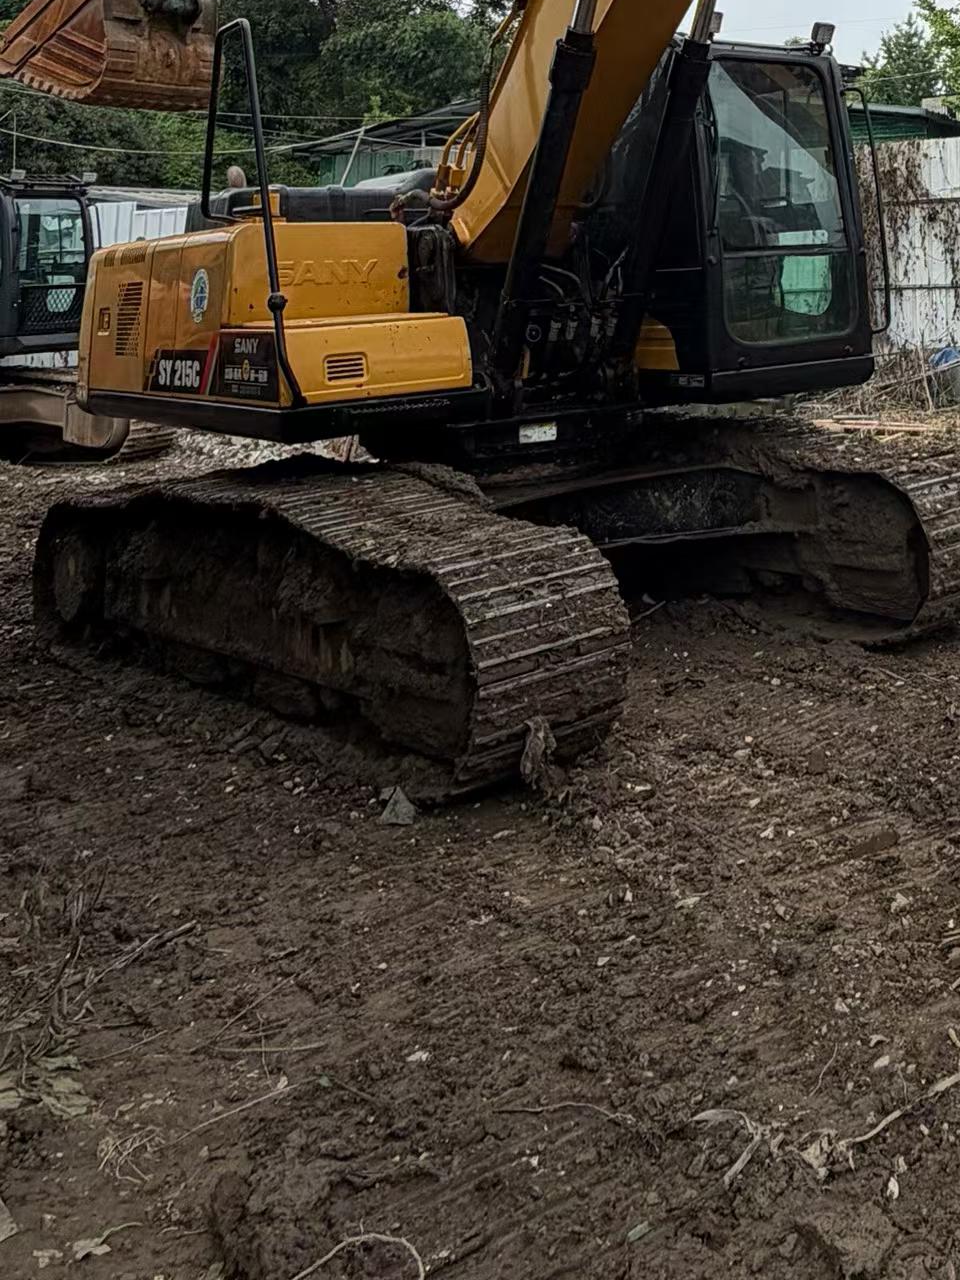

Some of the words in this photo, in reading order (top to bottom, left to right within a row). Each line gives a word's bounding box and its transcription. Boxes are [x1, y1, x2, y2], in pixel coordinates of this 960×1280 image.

[276, 258, 378, 287] SANY
[233, 337, 259, 354] SANY
[158, 359, 173, 387] SY
[174, 360, 200, 388] 215C
